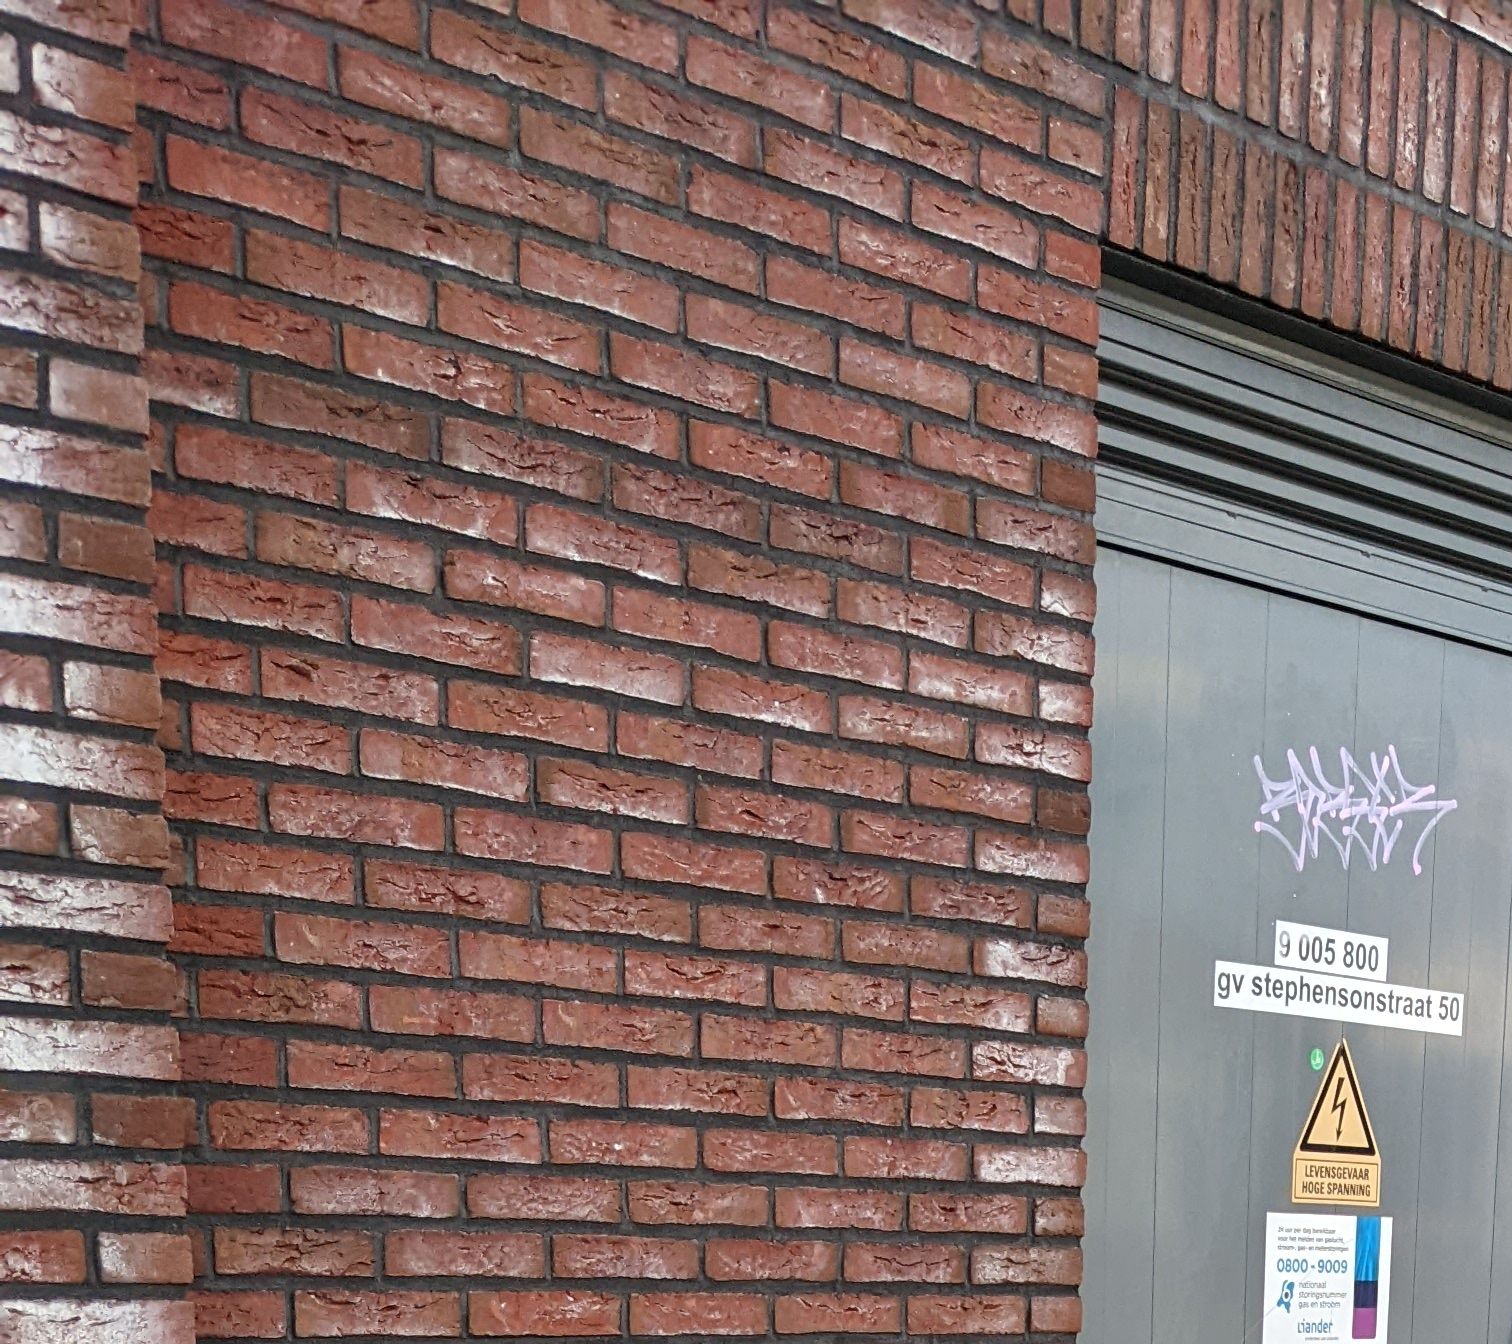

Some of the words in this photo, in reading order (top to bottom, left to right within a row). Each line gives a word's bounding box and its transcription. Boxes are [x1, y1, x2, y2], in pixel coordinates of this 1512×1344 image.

[1279, 931, 1291, 958] 9
[1299, 934, 1336, 965] 005
[1343, 941, 1379, 972] 800
[1217, 972, 1245, 1000] gv
[1251, 972, 1433, 1019] stephensonstraat
[1439, 996, 1460, 1021] 50
[1305, 1165, 1370, 1180] LEVENSGEVAAR
[1302, 1181, 1325, 1194] HOGE
[1327, 1182, 1371, 1197] SPANNING
[1277, 1258, 1308, 1273] 0800
[1318, 1259, 1348, 1273] 9009
[1299, 1291, 1347, 1299] storingsnummer
[1298, 1301, 1309, 1309] gas
